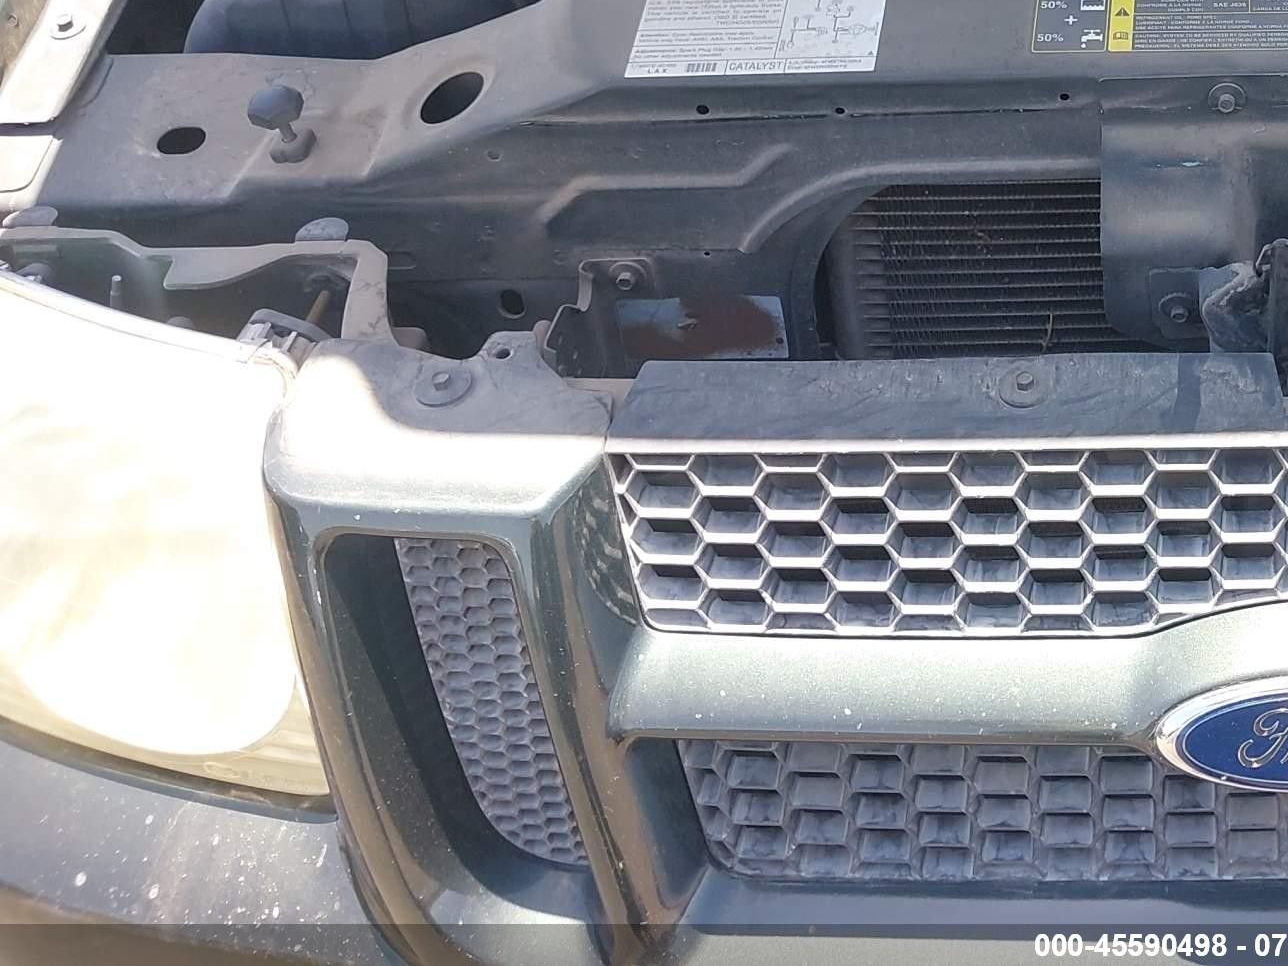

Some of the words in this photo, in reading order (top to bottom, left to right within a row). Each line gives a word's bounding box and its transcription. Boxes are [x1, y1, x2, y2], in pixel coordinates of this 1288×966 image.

[1040, 0, 1067, 10] 50%
[1036, 33, 1064, 42] 50%
[729, 61, 783, 71] CATALYST
